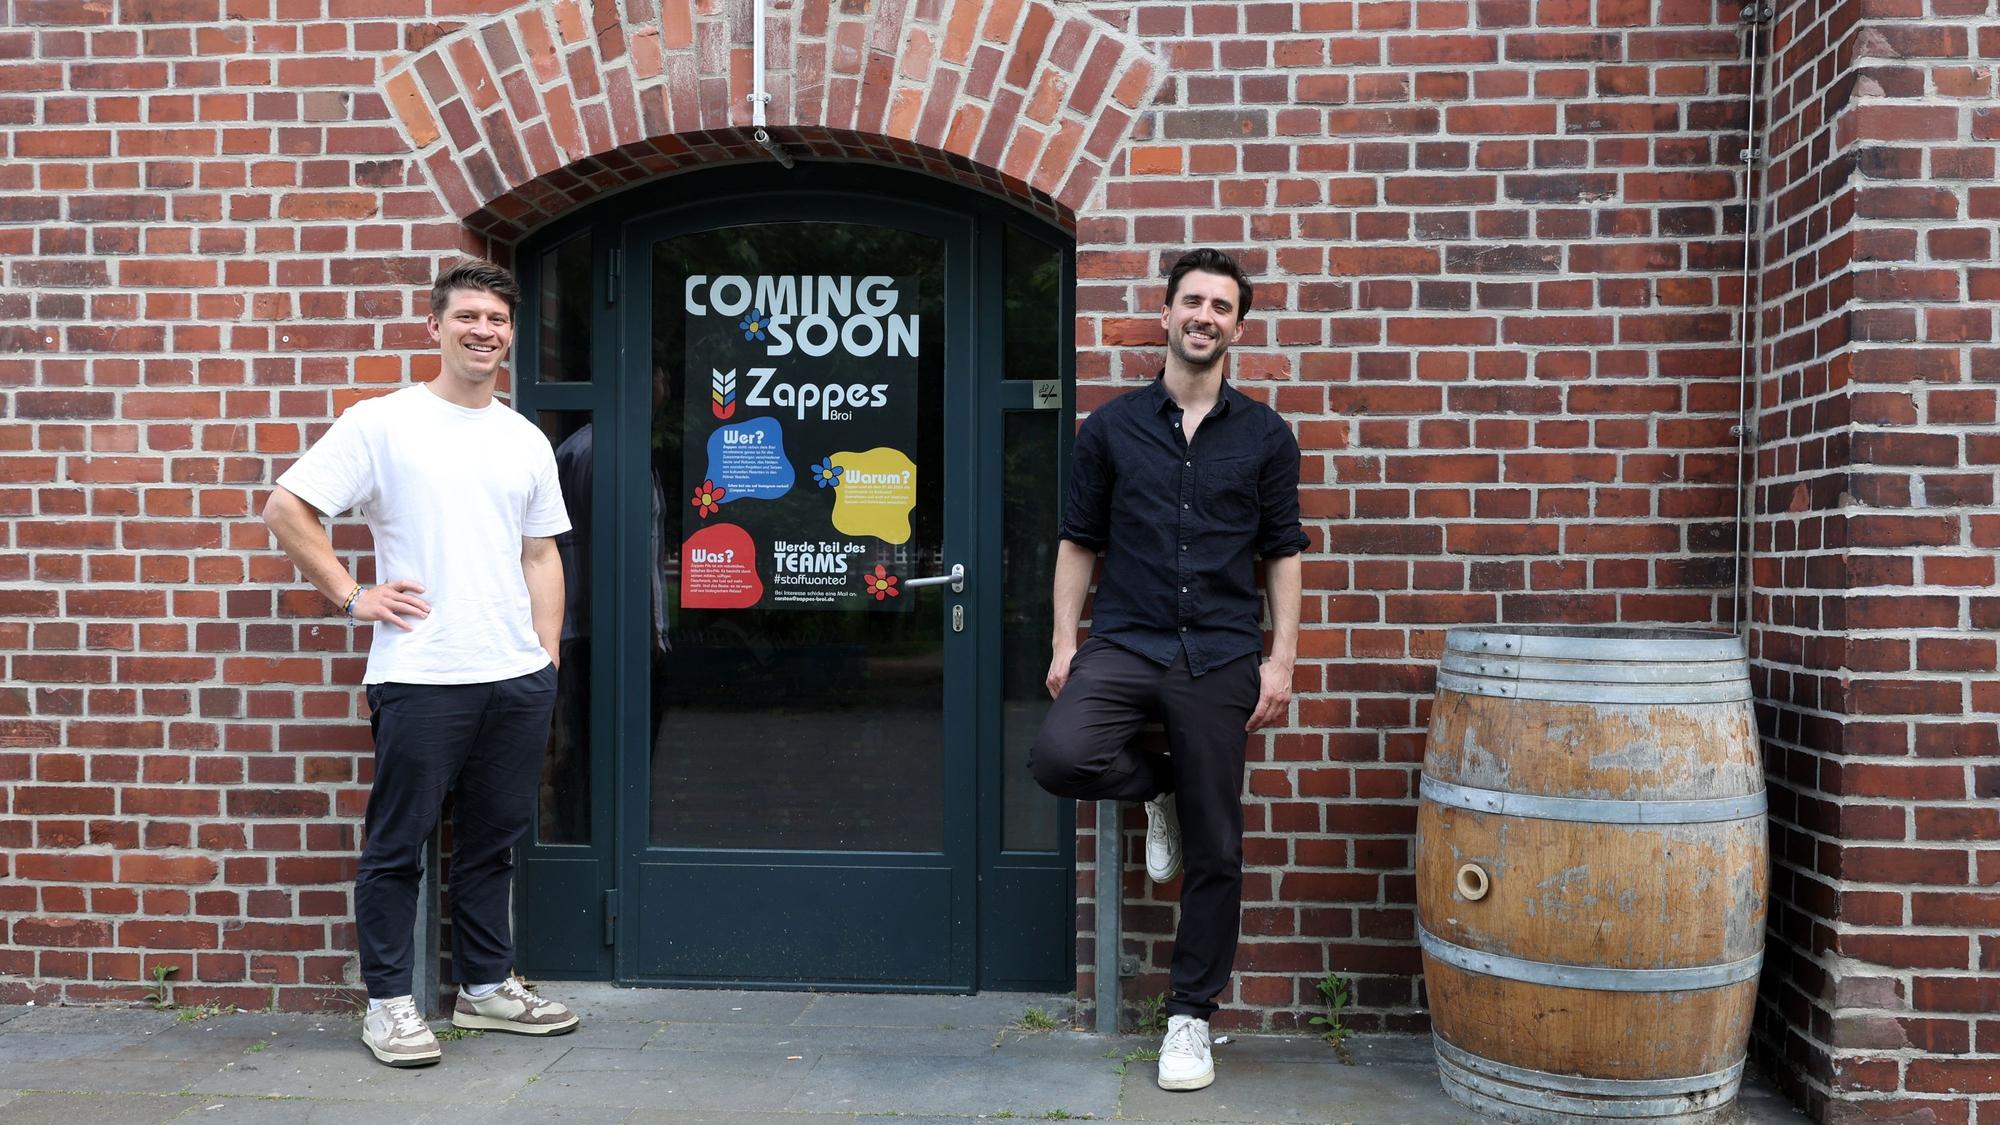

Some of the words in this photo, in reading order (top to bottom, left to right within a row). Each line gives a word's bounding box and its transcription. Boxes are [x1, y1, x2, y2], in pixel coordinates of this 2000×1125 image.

[686, 275, 899, 317] COMING
[766, 313, 919, 358] SOON
[745, 368, 889, 420] Zappes
[830, 410, 852, 421] Broi
[723, 430, 765, 444] Wer?
[845, 470, 911, 484] Warum?
[774, 541, 815, 552] Werde
[819, 542, 840, 553] Teil
[844, 542, 866, 553] des
[691, 549, 734, 563] Was?
[774, 553, 848, 573] TEAMS
[774, 574, 847, 586] #staffwanted
